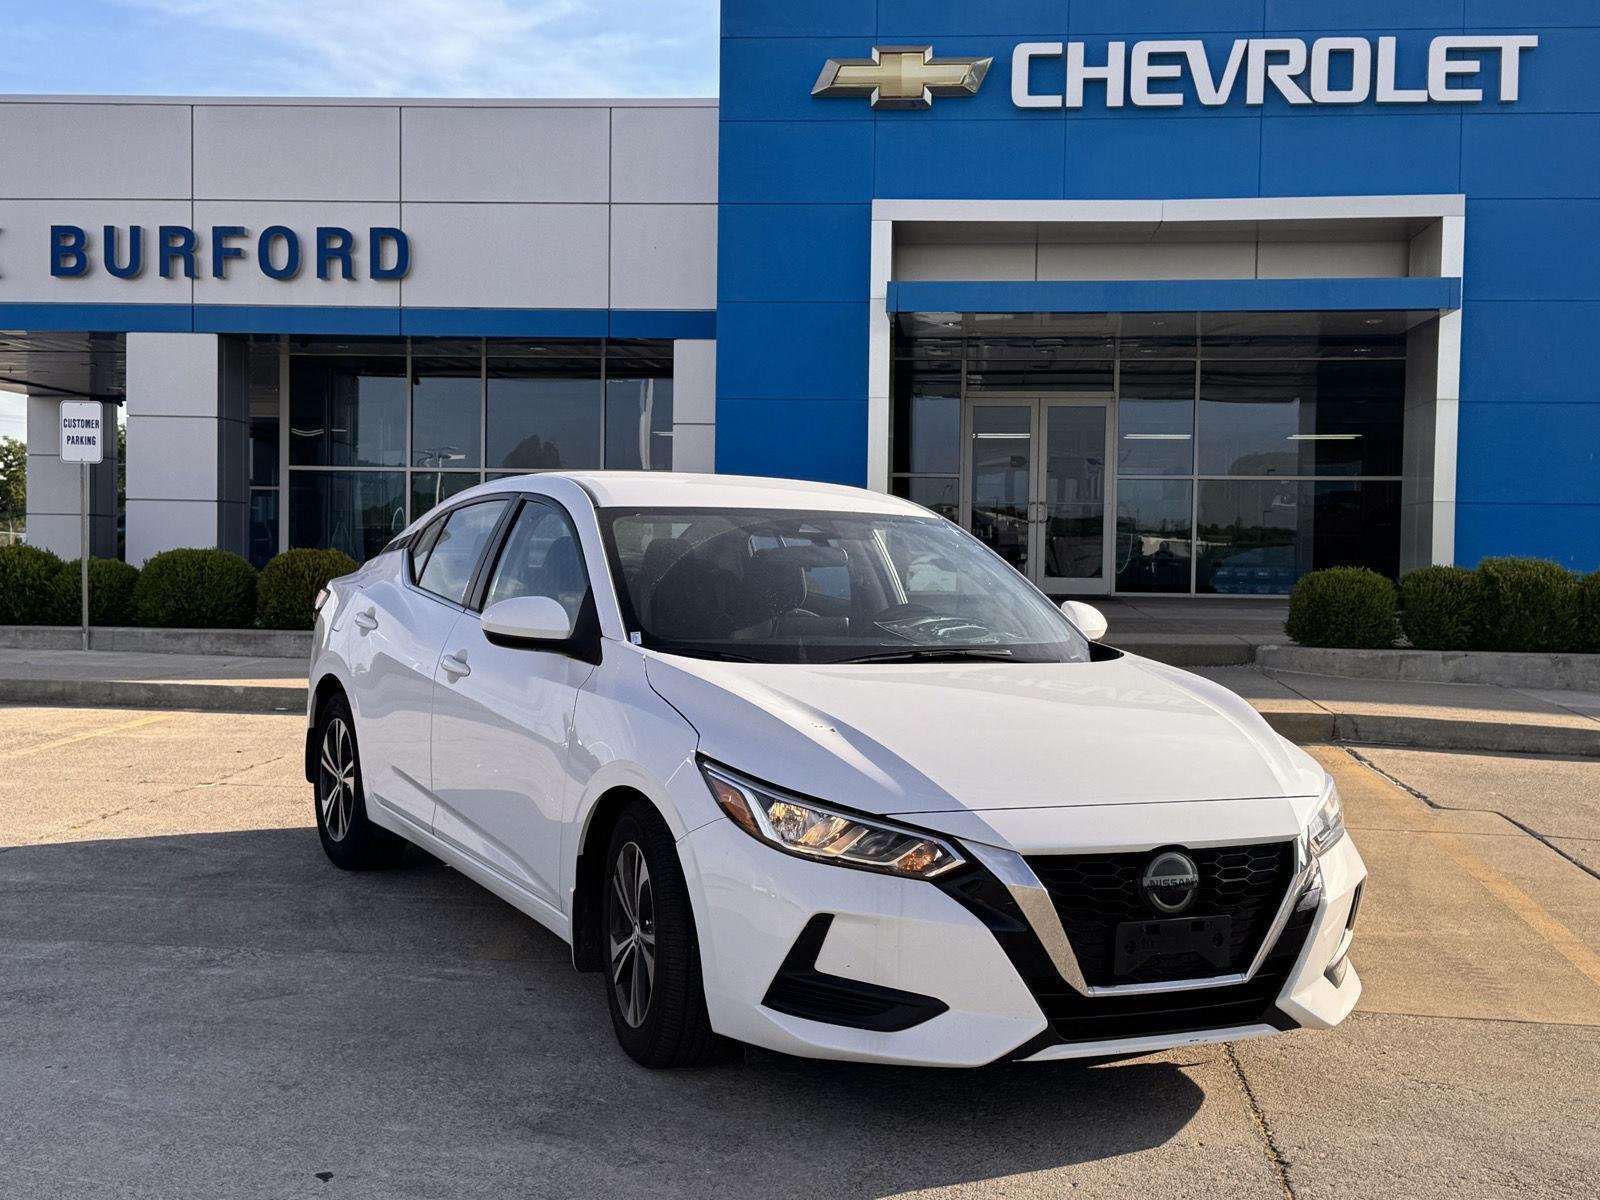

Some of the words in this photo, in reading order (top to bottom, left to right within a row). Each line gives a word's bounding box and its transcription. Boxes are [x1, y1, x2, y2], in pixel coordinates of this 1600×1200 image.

[1011, 35, 1539, 108] CHEVROLET
[50, 225, 410, 280] BURFORD
[63, 418, 99, 429] CUSTOMER
[66, 435, 96, 446] PARKING
[1148, 878, 1194, 889] NISSAN
